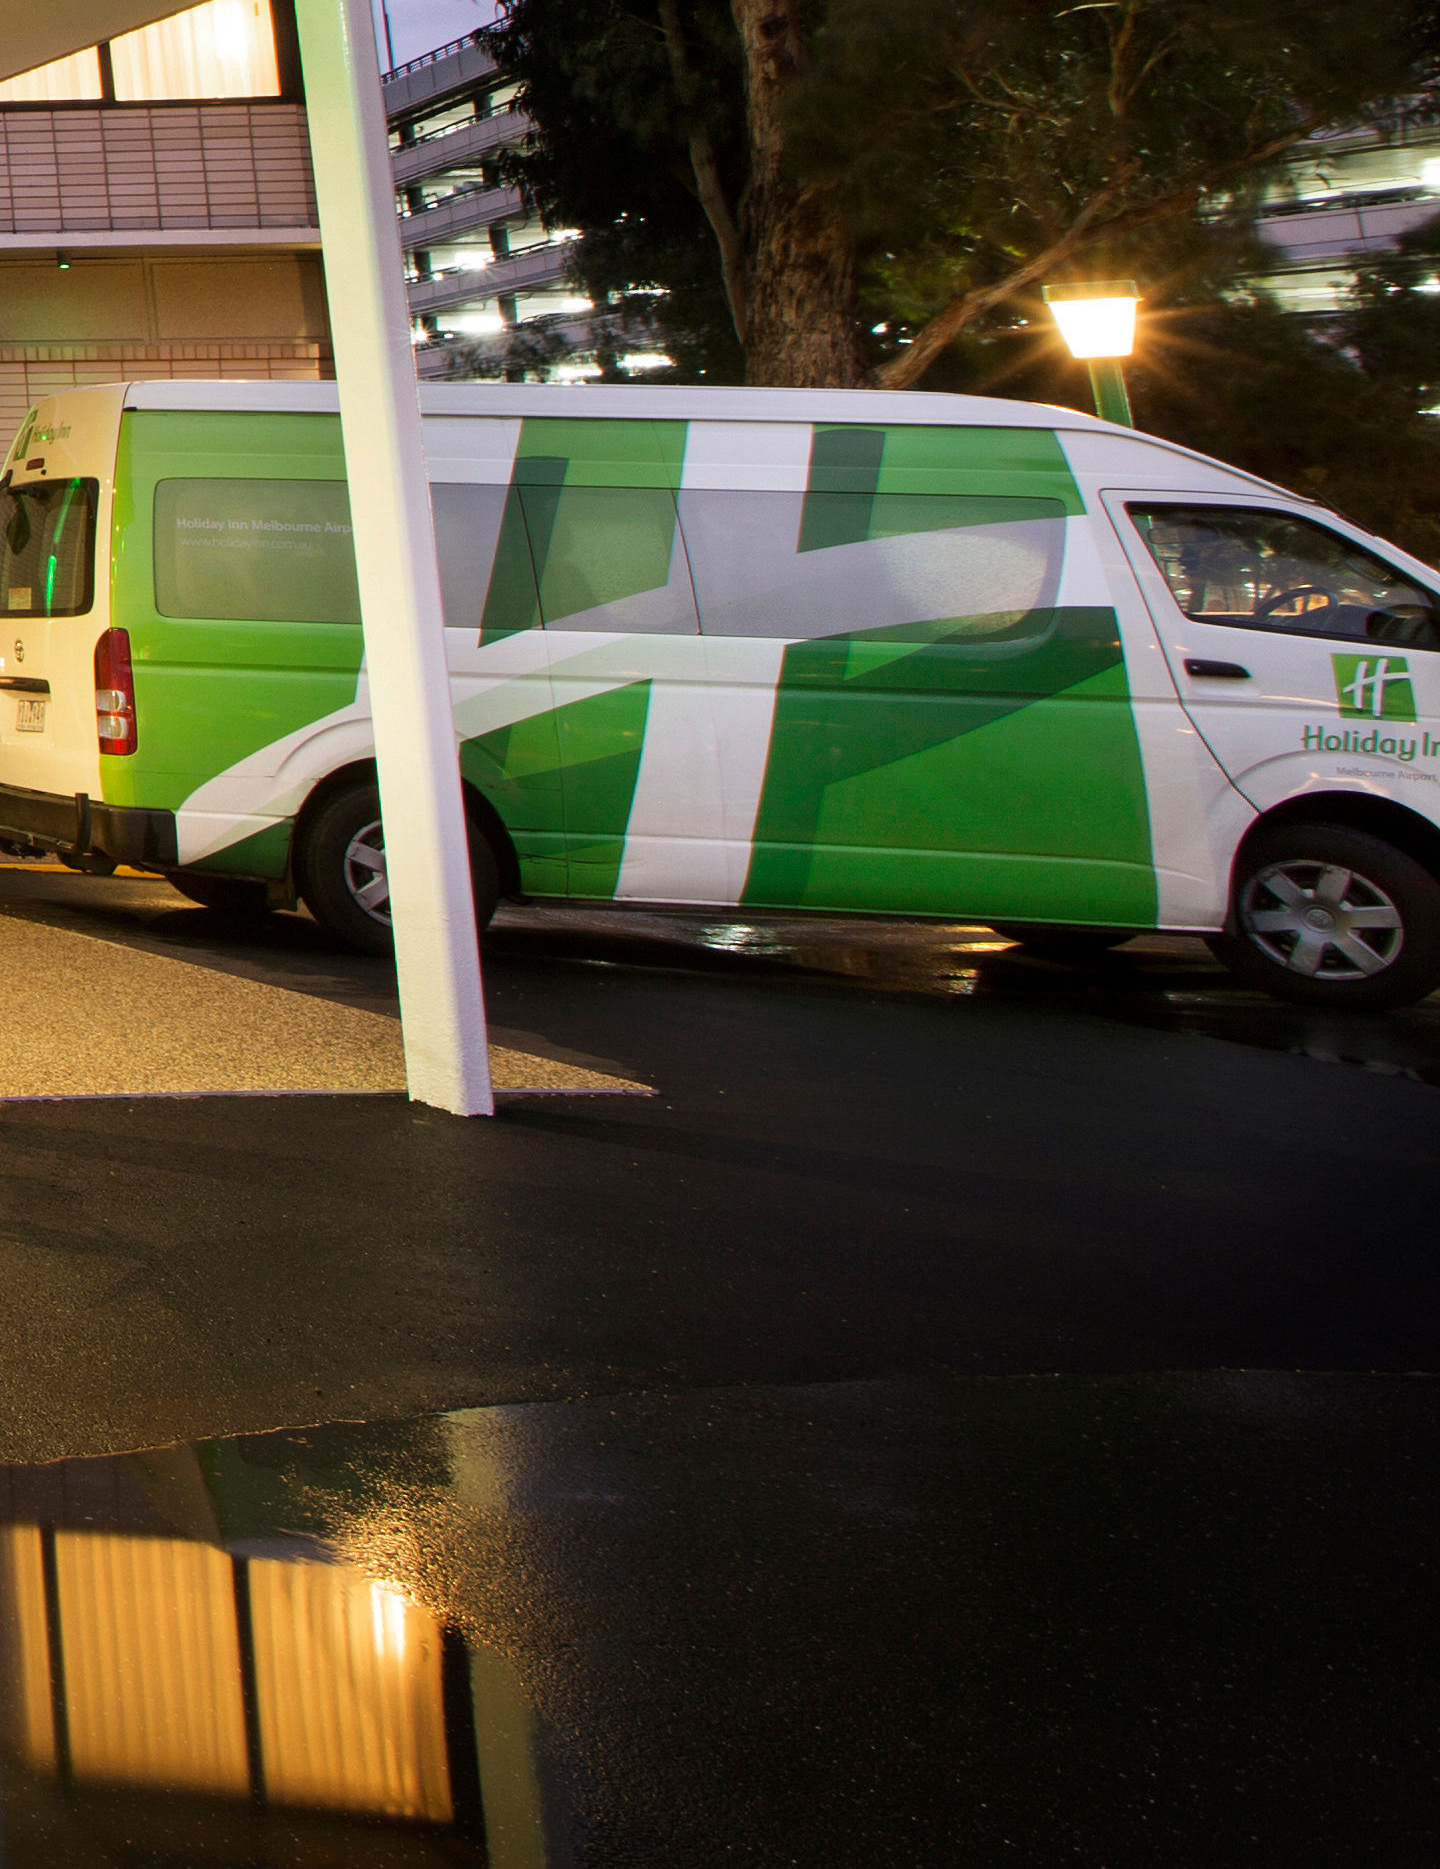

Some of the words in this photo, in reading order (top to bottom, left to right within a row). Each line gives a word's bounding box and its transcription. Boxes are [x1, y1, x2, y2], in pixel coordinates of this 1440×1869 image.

[176, 518, 224, 532] Holiday
[228, 519, 248, 530] Inn
[252, 520, 321, 533] Melbourne
[324, 522, 352, 535] Airp
[1300, 725, 1417, 761] Holiday
[1423, 731, 1440, 757] In
